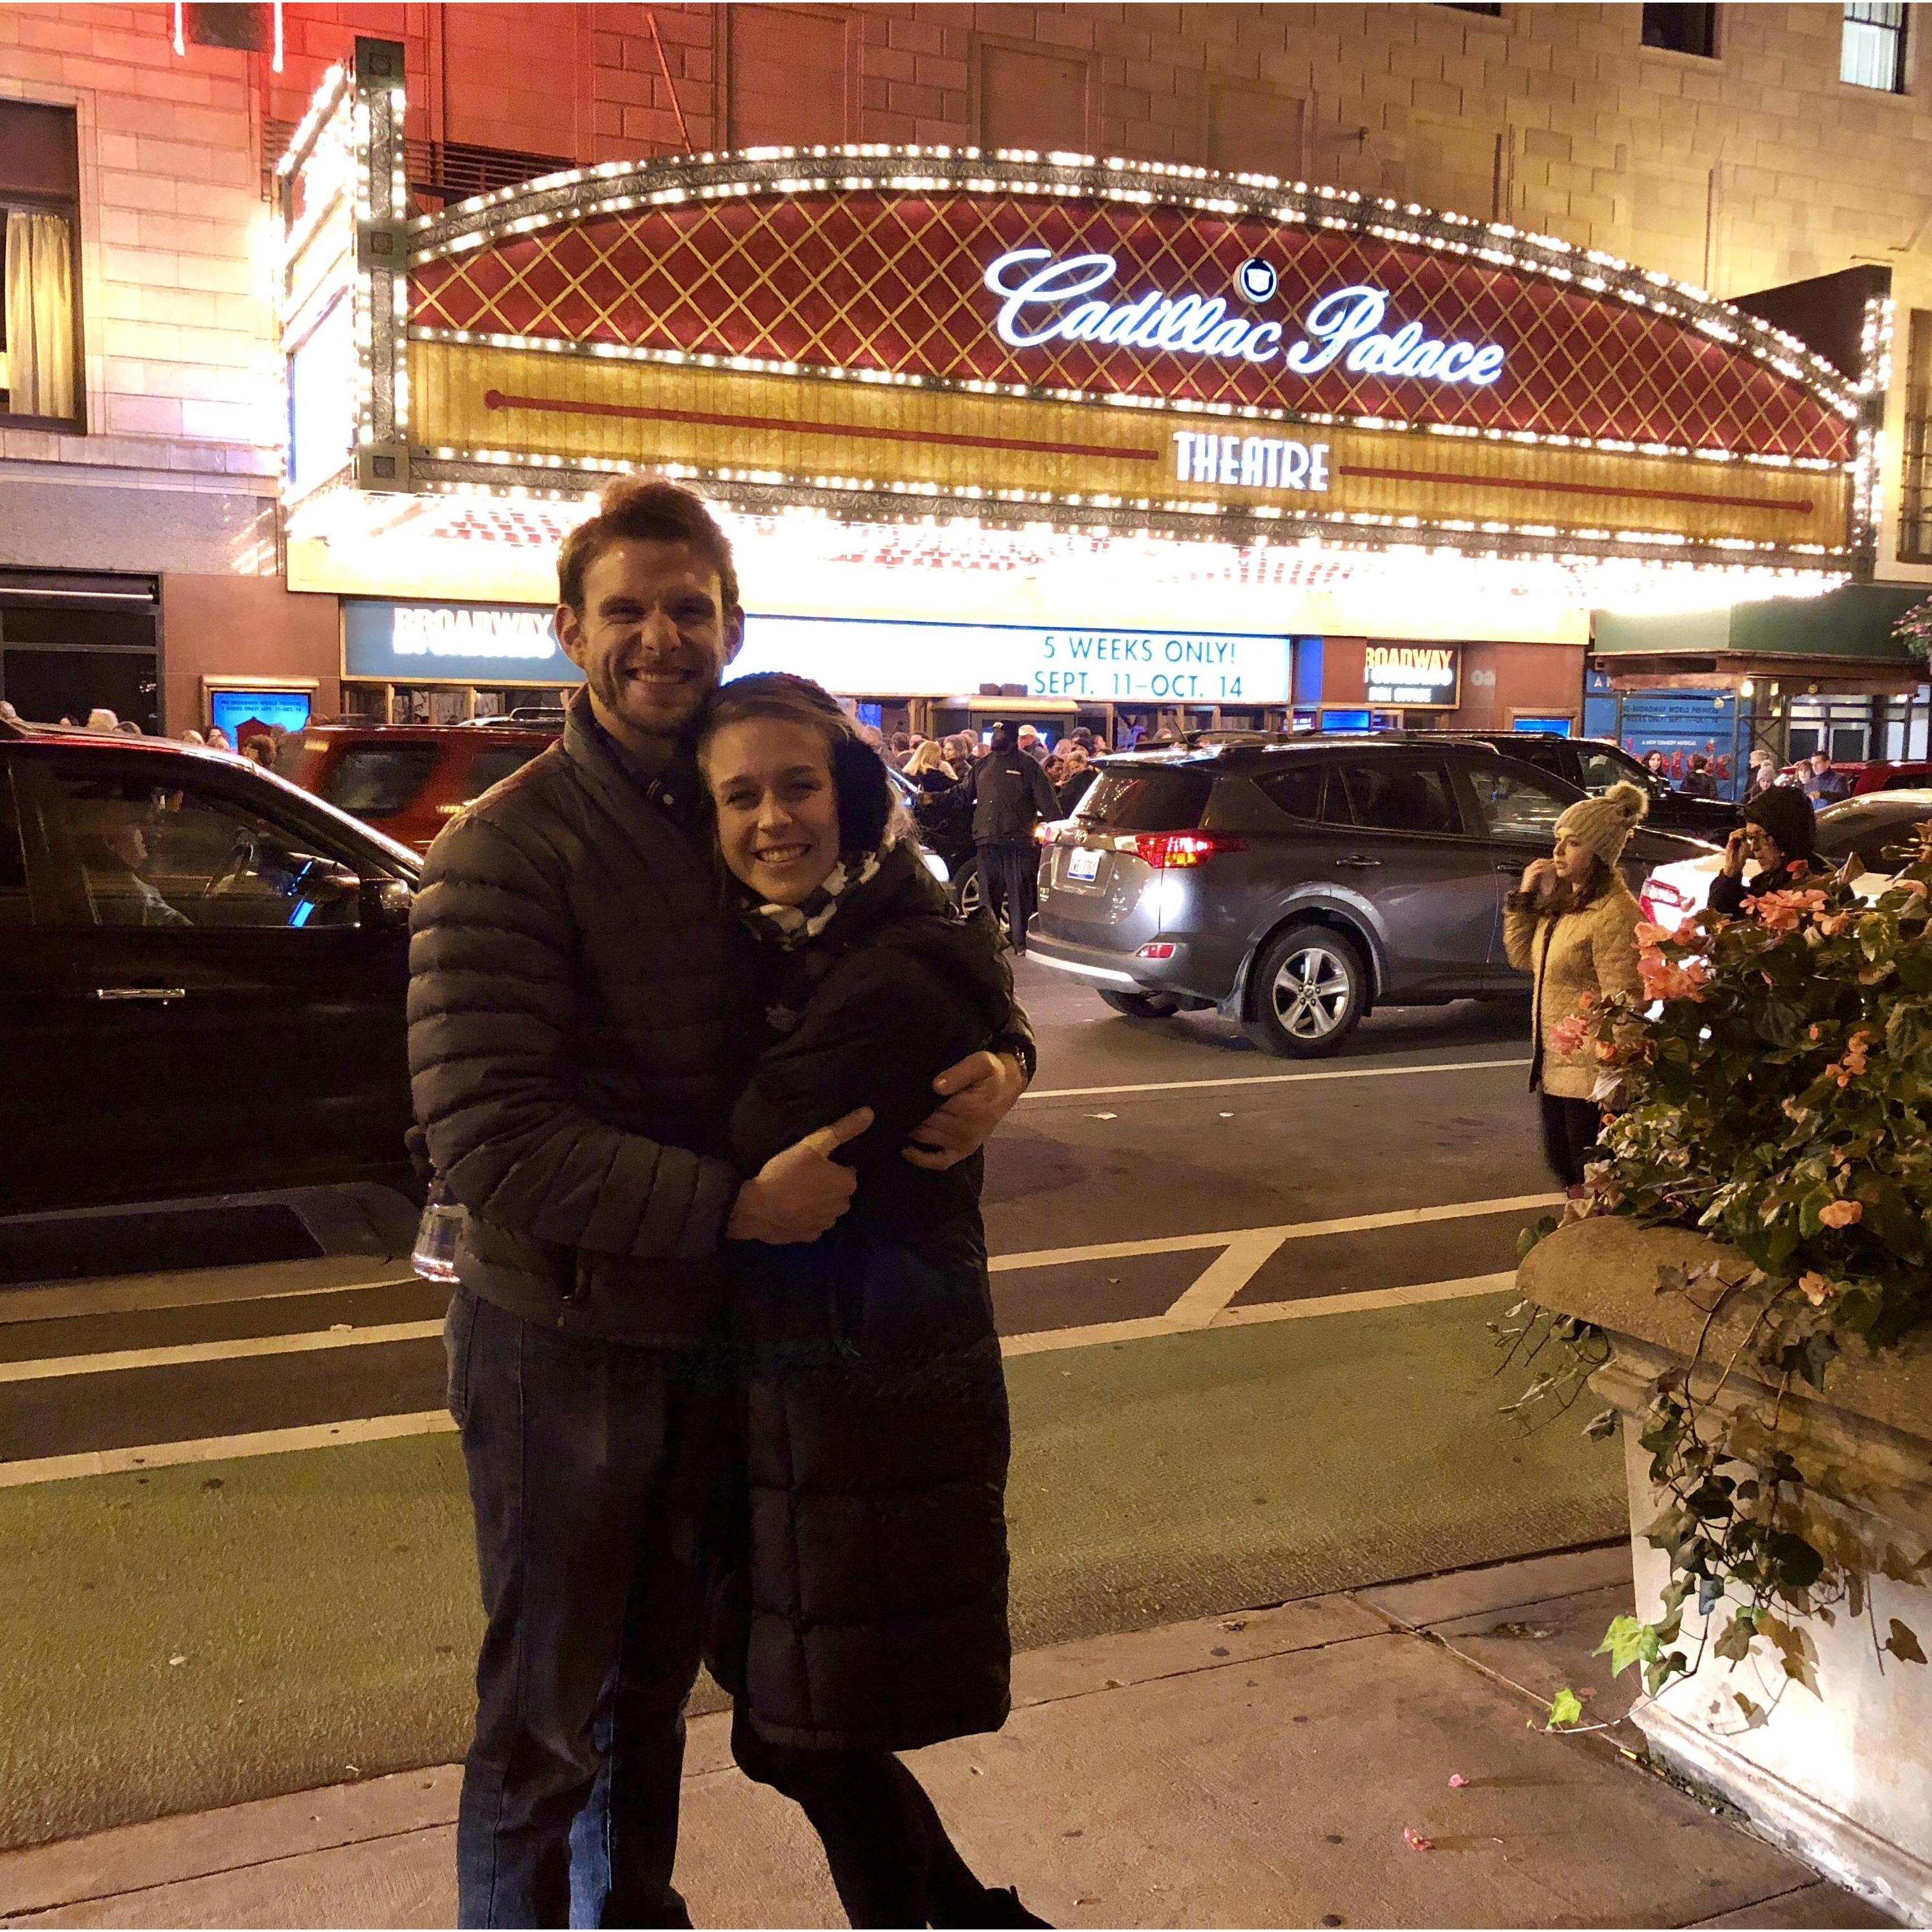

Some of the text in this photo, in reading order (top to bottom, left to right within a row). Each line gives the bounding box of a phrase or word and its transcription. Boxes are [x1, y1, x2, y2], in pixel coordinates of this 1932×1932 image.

[984, 249, 1504, 384] Cadillac Palace
[1172, 431, 1329, 492] THEATRE
[393, 607, 554, 638] BROADWAY
[1044, 636, 1235, 664] 5 WEEKS ONLY!
[1366, 647, 1453, 670] ROADWAY
[1034, 671, 1094, 695] SEPT.
[1220, 676, 1243, 698] 14
